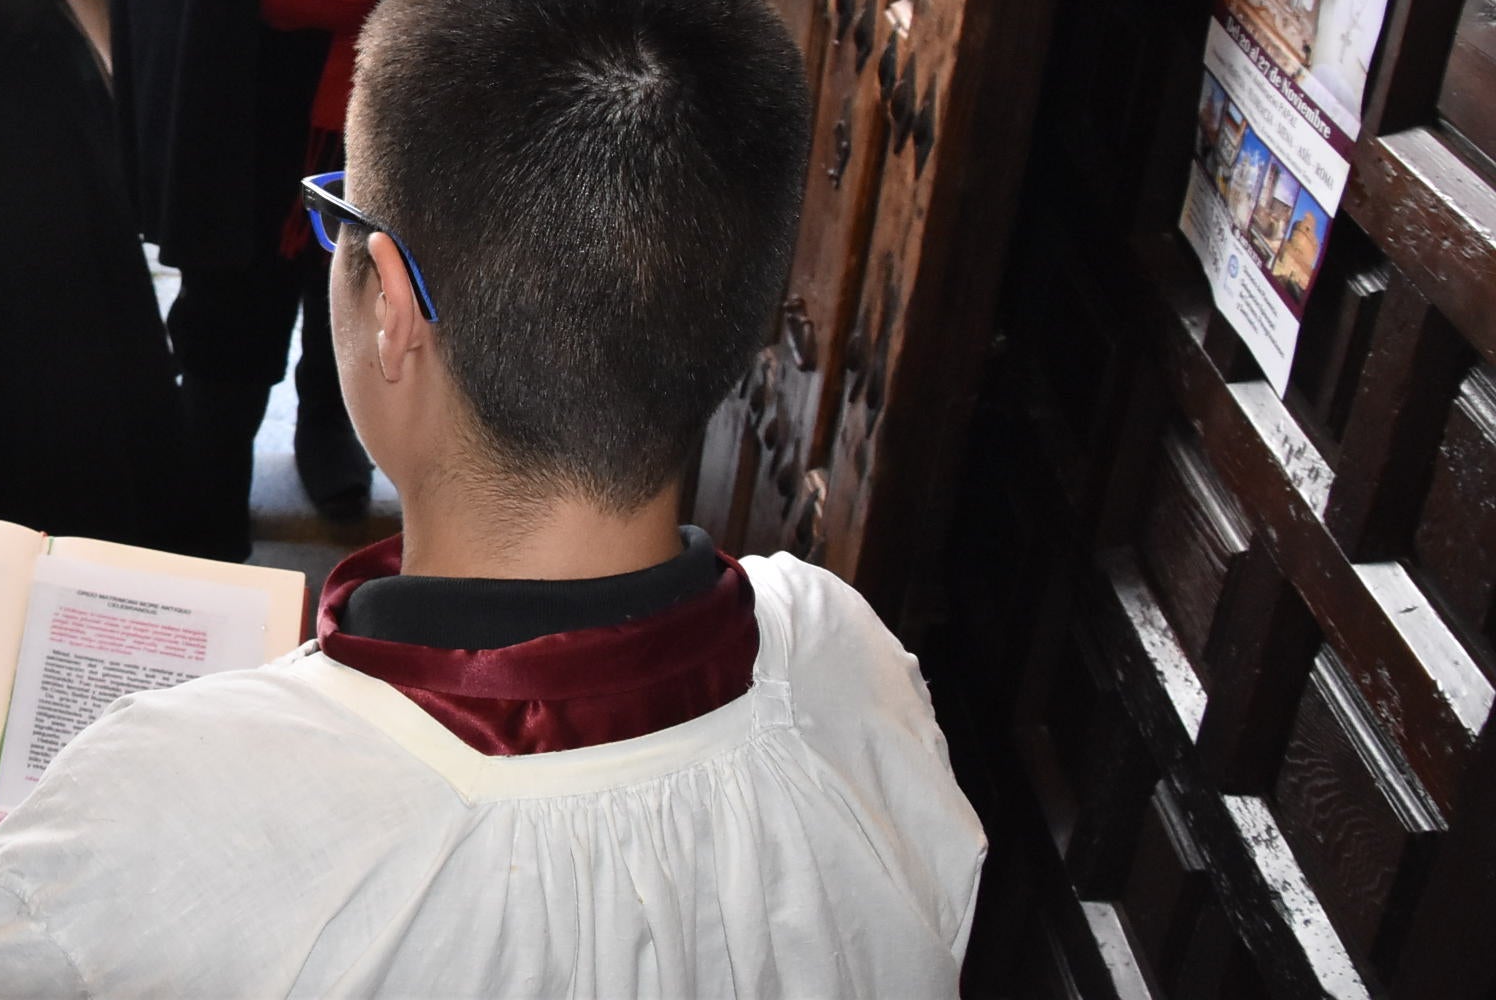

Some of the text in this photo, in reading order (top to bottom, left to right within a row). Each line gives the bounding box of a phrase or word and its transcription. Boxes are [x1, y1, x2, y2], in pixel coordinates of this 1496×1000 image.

[1239, 36, 1251, 53] 20
[1249, 47, 1260, 62] al
[1258, 56, 1271, 76] 27
[1269, 65, 1282, 89] de
[1280, 76, 1332, 140] Noviembre
